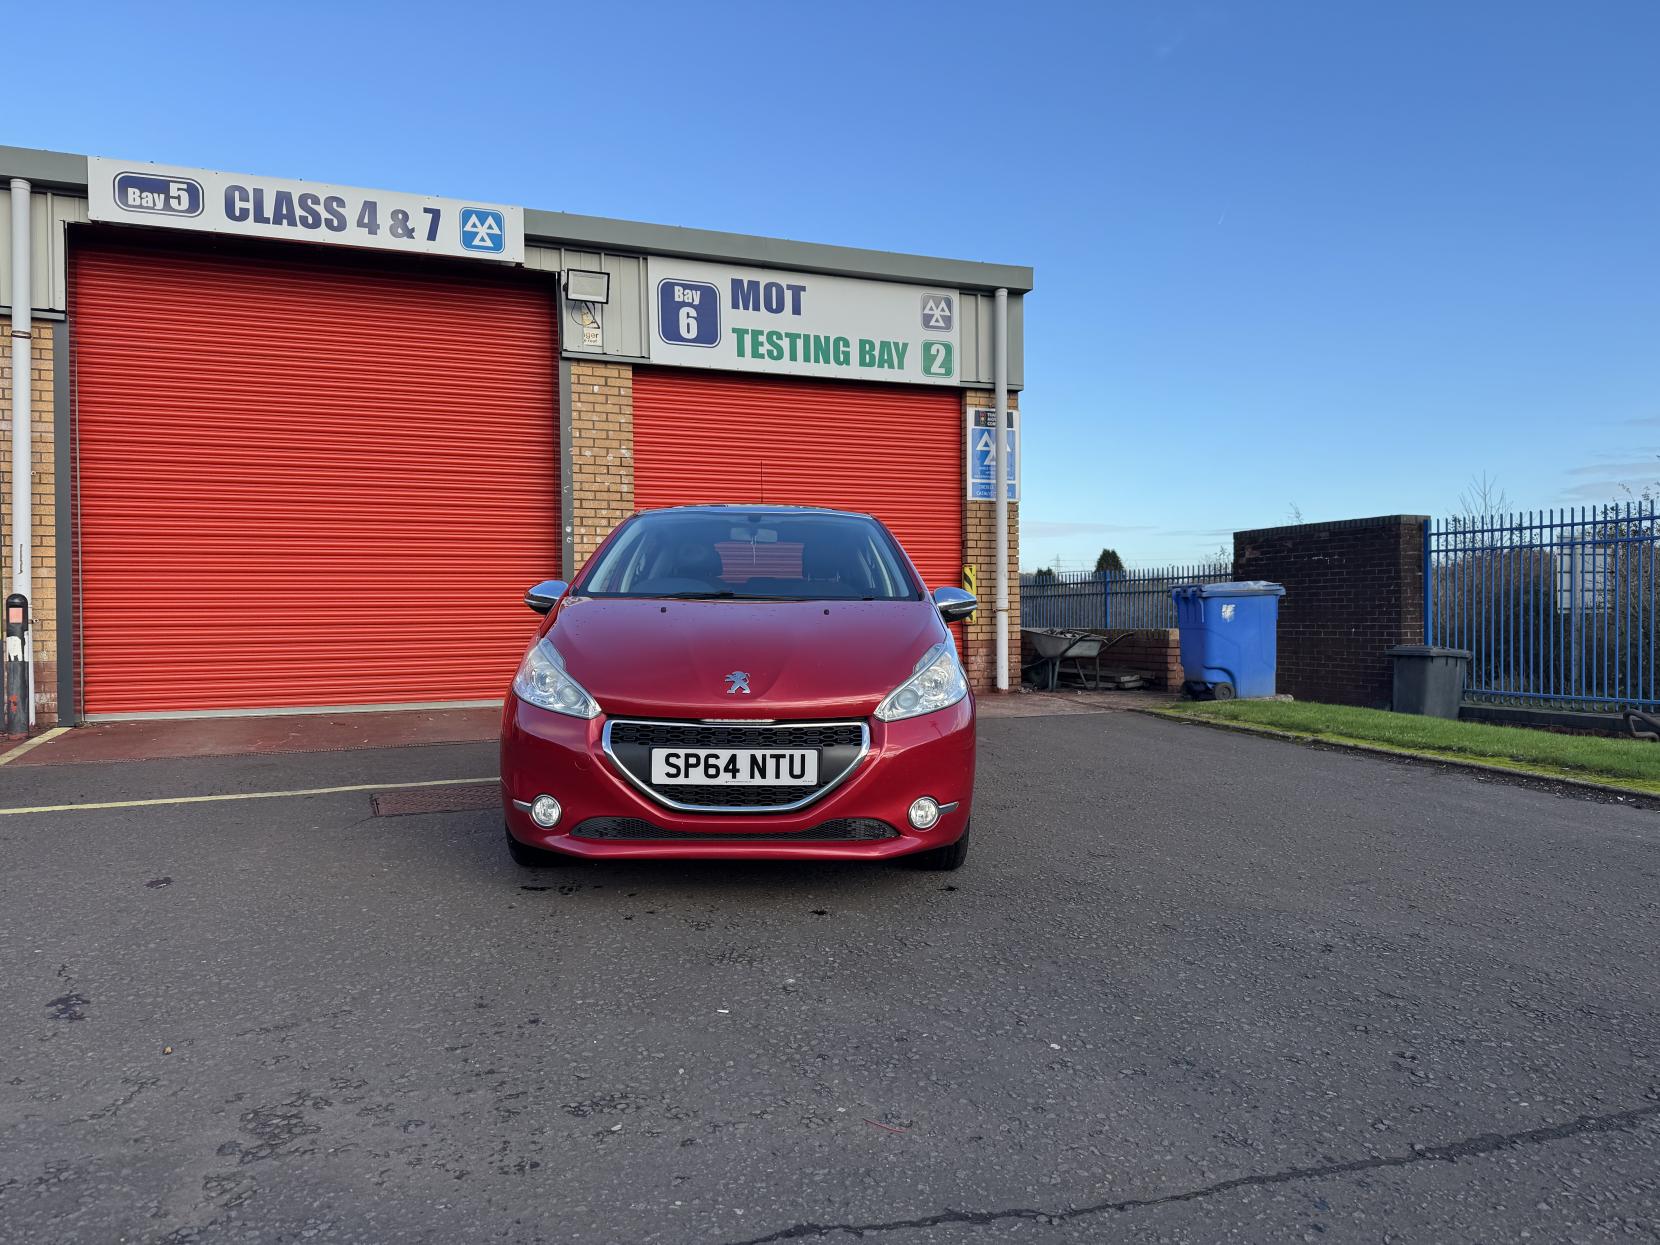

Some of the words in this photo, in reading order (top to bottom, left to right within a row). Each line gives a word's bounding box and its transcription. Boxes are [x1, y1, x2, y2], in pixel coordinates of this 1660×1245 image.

[127, 188, 165, 210] Bay
[169, 182, 189, 211] 5
[224, 184, 347, 232] CLASS
[356, 200, 380, 235] 4
[389, 209, 415, 239] &
[423, 207, 441, 241] 7
[674, 286, 701, 305] Bay
[730, 278, 807, 316] MOT
[678, 306, 698, 340] 6
[731, 327, 851, 367] TESTING
[858, 338, 909, 370] BAY
[930, 343, 946, 374] 2
[664, 752, 740, 780] SP64
[749, 753, 806, 780] NTU
